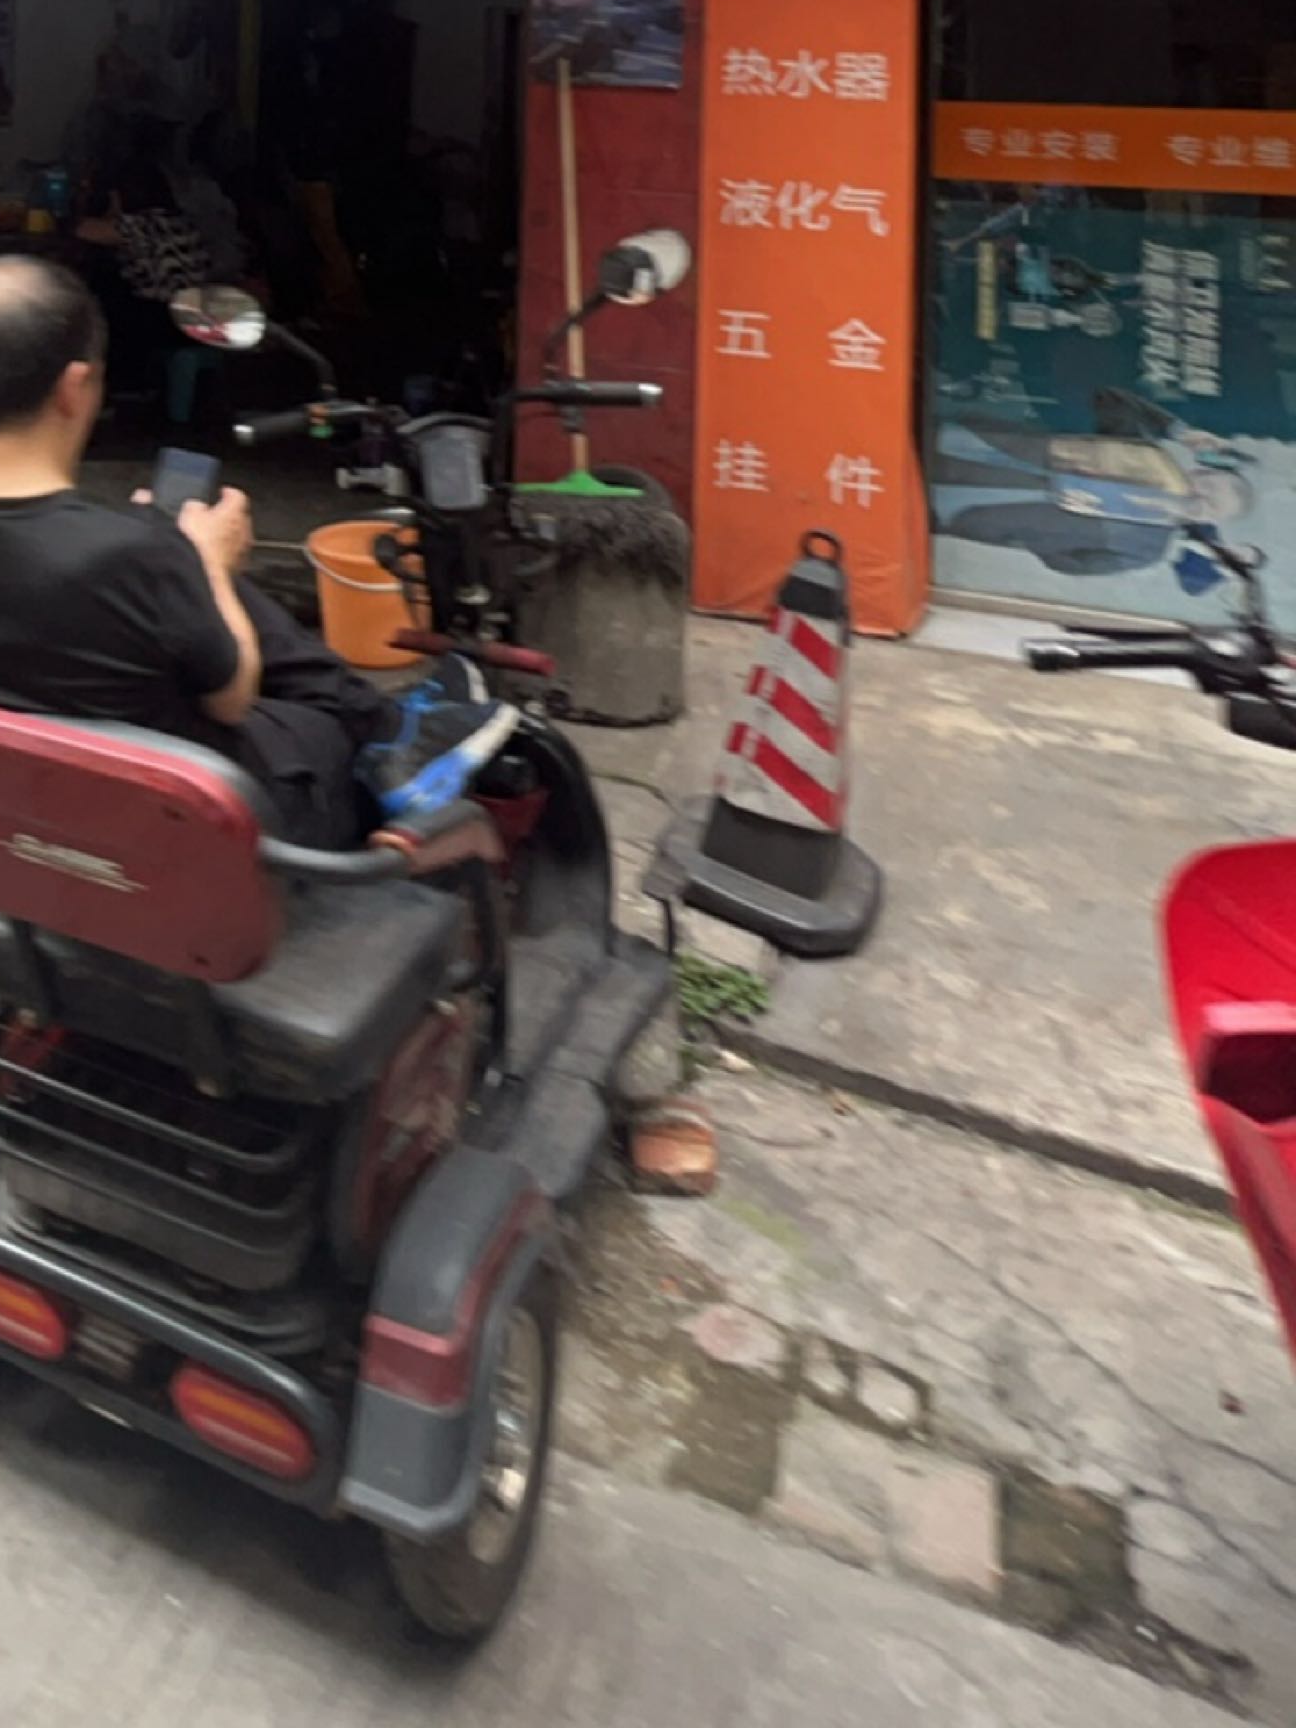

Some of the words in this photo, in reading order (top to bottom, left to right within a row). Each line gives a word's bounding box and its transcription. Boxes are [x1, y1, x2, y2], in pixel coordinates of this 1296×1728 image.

[720, 49, 890, 102] 热水器
[718, 178, 890, 237] 液化气
[715, 308, 887, 371] 五金
[713, 438, 885, 508] 挂件
